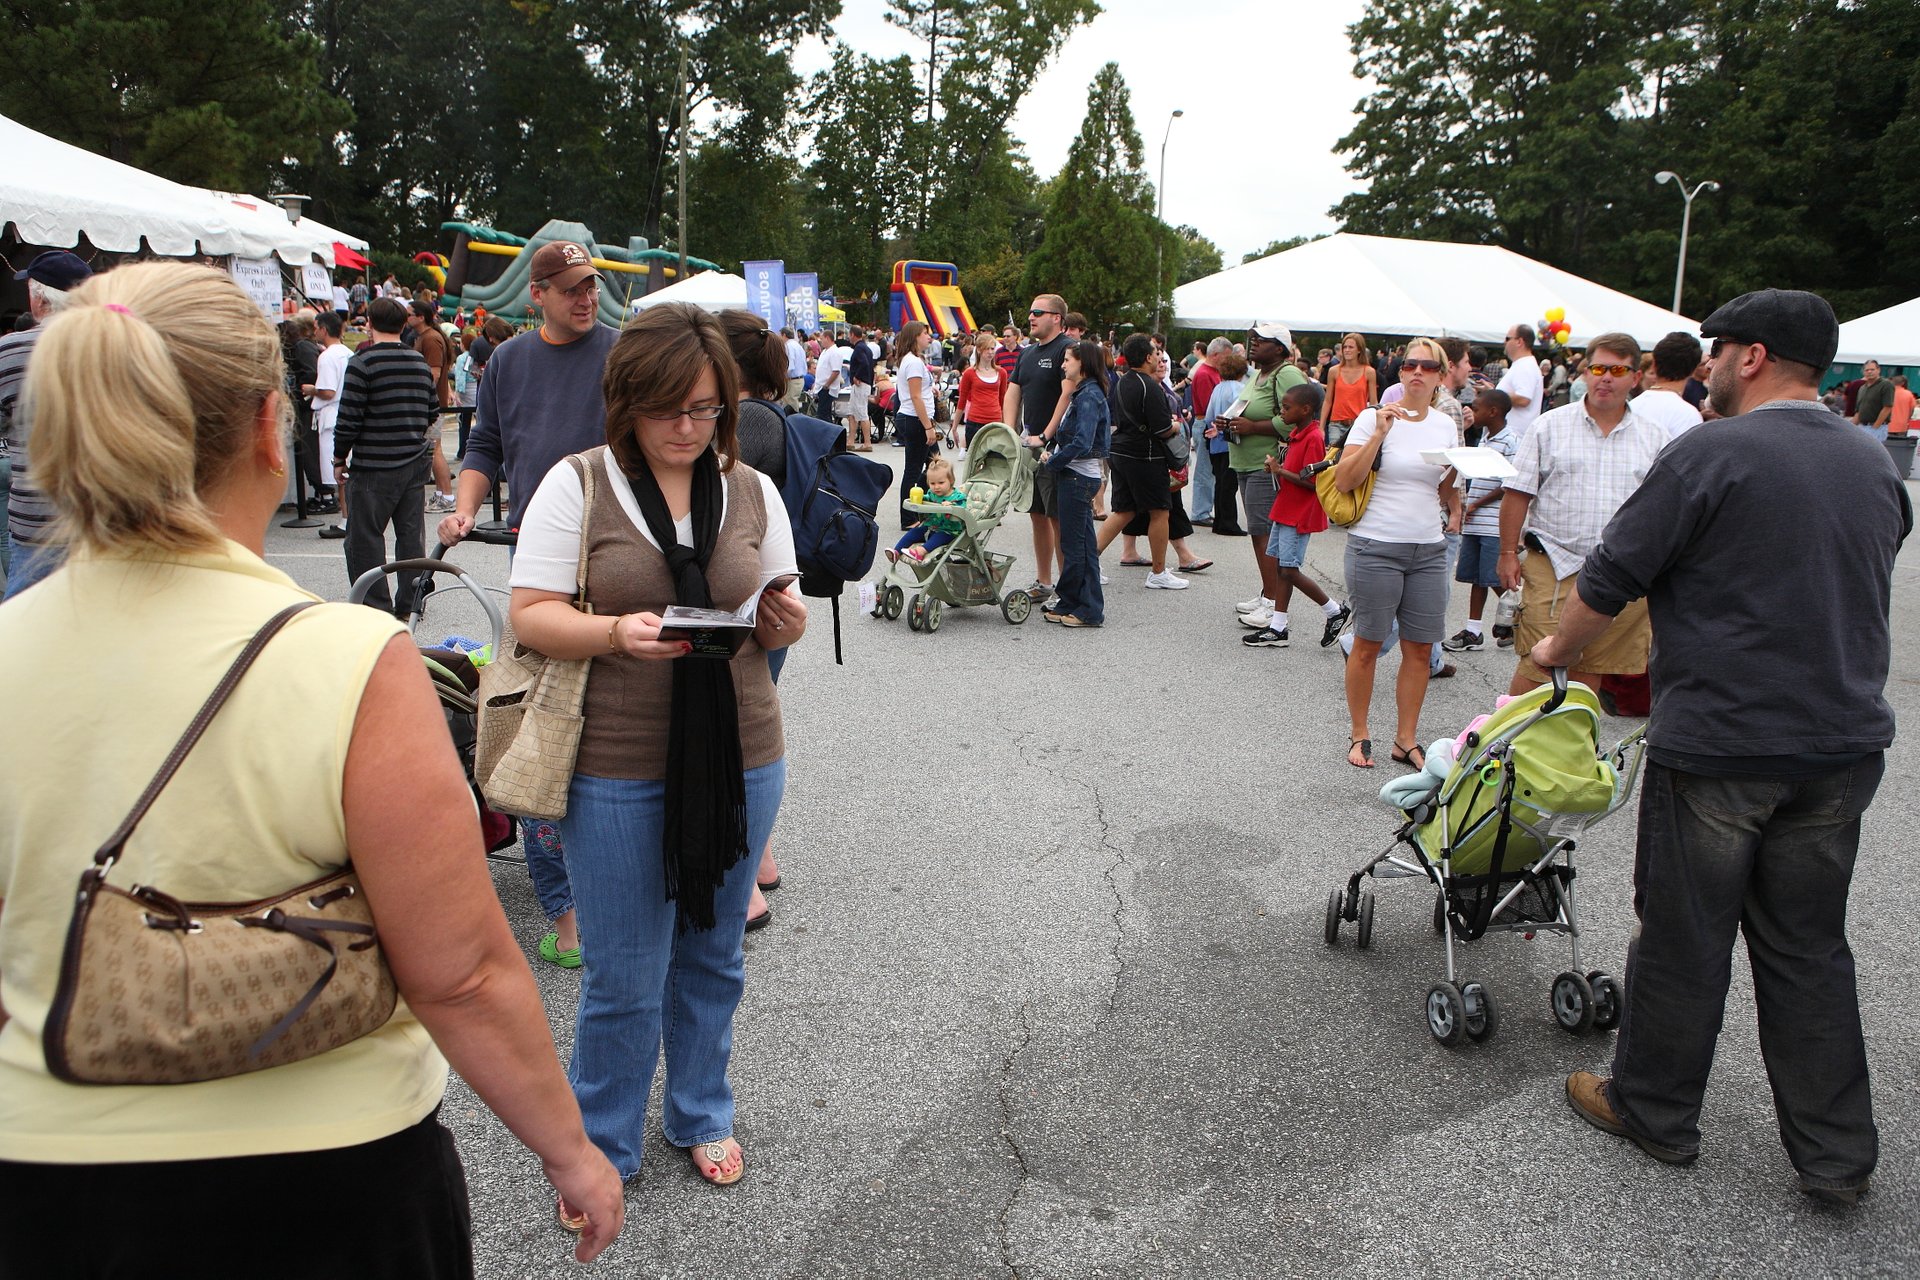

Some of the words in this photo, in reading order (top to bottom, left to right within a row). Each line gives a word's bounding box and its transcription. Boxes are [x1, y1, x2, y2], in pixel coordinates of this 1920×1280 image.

[235, 263, 260, 276] Express
[261, 266, 280, 276] Tickets
[308, 269, 325, 279] CASH
[251, 279, 266, 288] Only
[310, 282, 327, 292] ONLY
